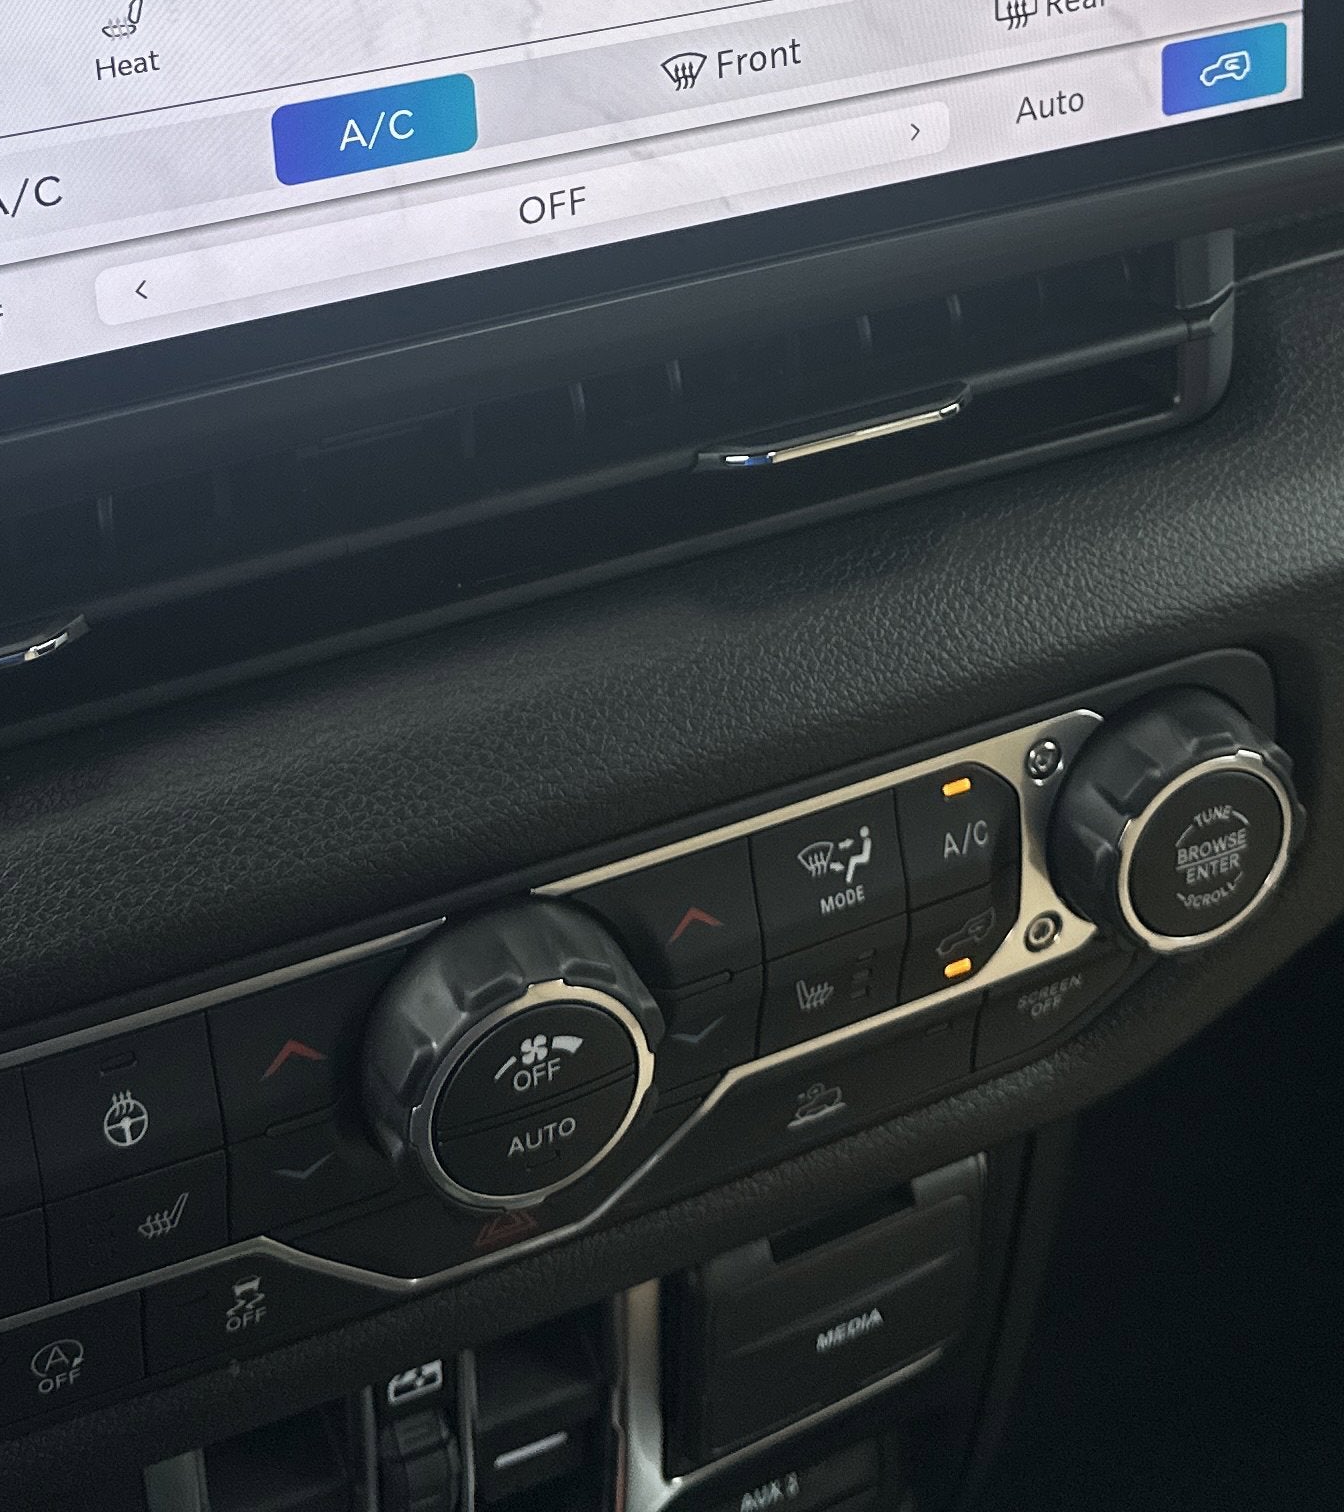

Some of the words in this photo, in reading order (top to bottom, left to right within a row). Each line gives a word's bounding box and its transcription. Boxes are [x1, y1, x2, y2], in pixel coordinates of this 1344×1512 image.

[95, 49, 161, 80] Heat
[717, 38, 802, 80] Front
[1015, 88, 1085, 124] Auto
[339, 109, 415, 151] A/C
[518, 186, 587, 224] OFF
[1193, 804, 1233, 829] TUNE
[944, 819, 989, 859] A/C
[1177, 828, 1248, 865] BROWSE
[1186, 853, 1241, 884] ENTER
[820, 885, 866, 915] MODE
[1183, 883, 1236, 908] SCROLL
[513, 1057, 561, 1092] OFF
[508, 1117, 576, 1157] AUTO
[226, 1306, 267, 1332] OFF
[816, 1308, 884, 1351] MEDIA
[38, 1368, 81, 1393] OFF
